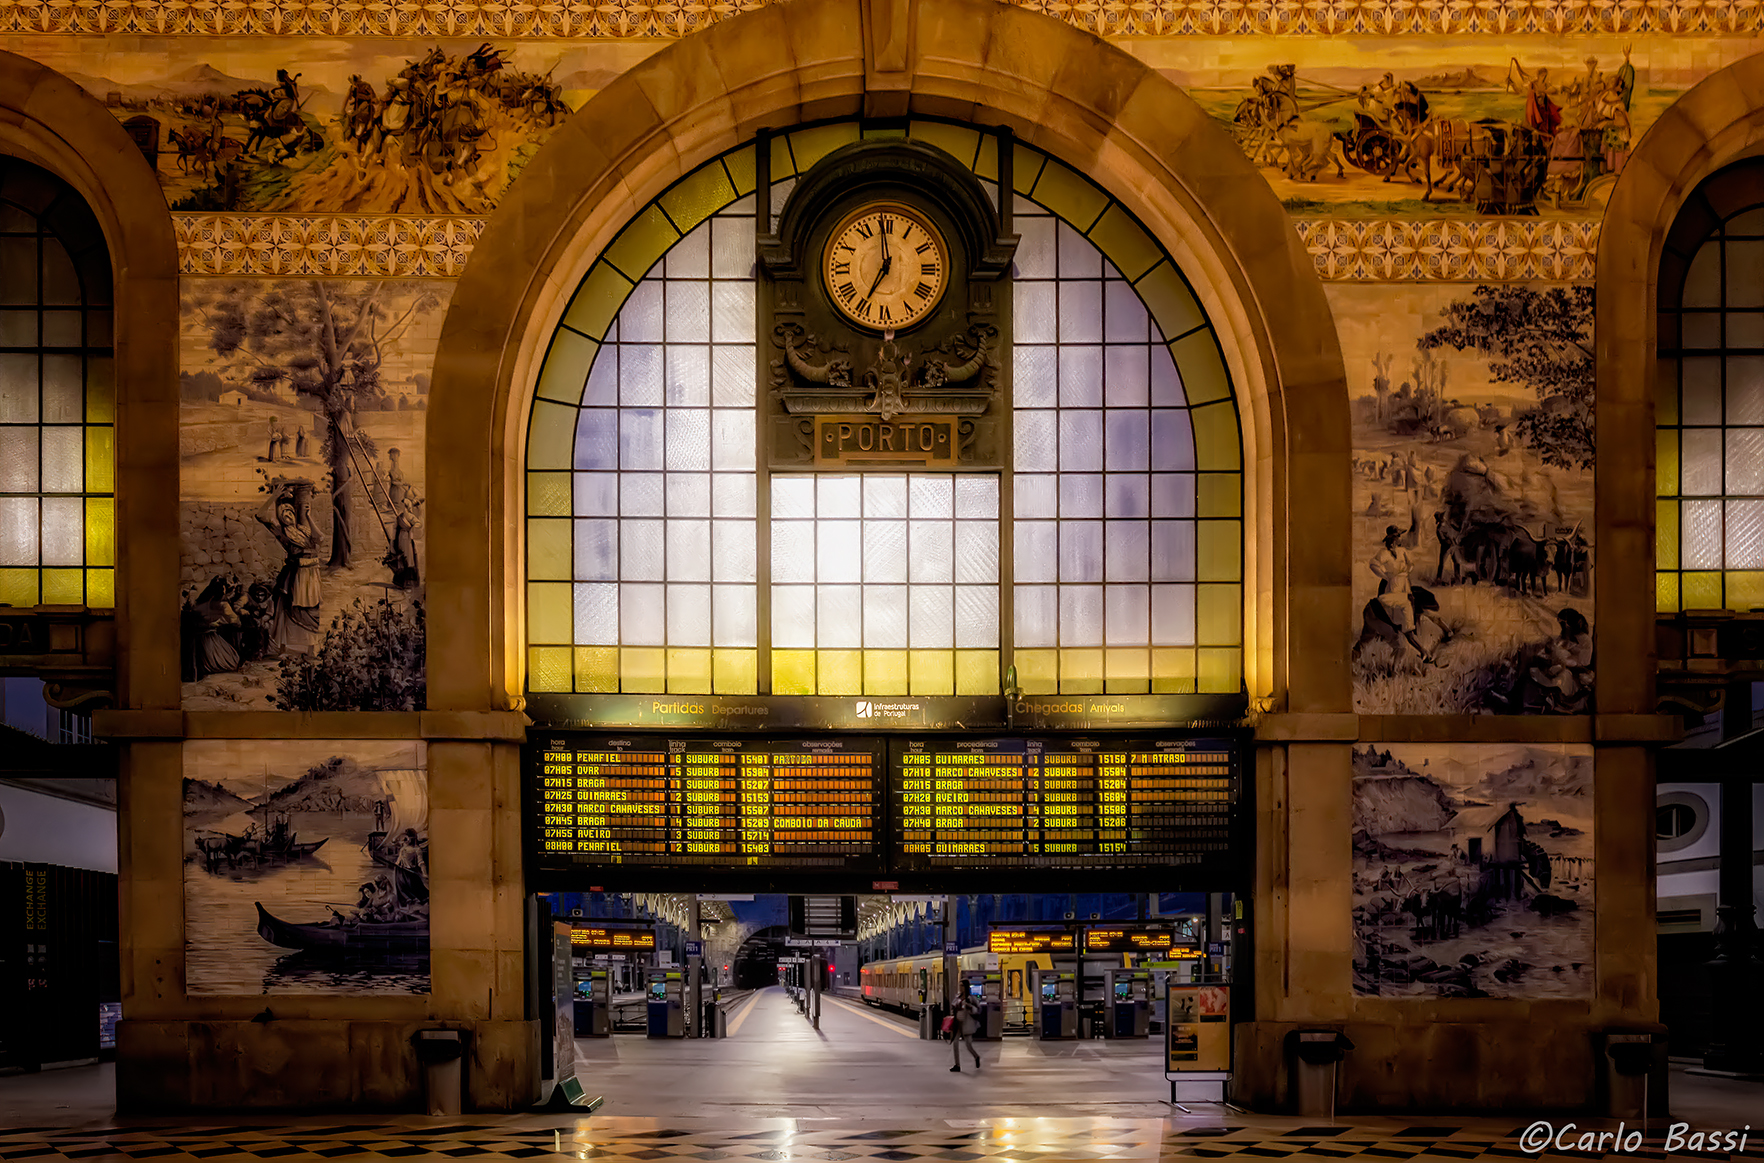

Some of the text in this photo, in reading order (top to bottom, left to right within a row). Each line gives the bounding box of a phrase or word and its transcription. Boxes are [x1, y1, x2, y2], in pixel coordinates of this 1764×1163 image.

[838, 424, 934, 451] PORTO
[652, 701, 769, 716] Partidas Departures
[874, 702, 920, 710] Infraestruturas
[1015, 701, 1125, 716] Chegadas Arrivals
[883, 710, 906, 719] Portugal
[544, 753, 572, 761] 07H00
[577, 754, 620, 762] PENAFIEL
[676, 755, 681, 763] 6
[687, 755, 719, 764] SUBURB
[741, 755, 769, 764] 15401
[903, 754, 1185, 764] 07H05 GUIMARAES 1 SUBURB 15150 7 M ATRASO
[544, 766, 769, 776] 07H05 OVAR 5 SUBURB 15904
[903, 767, 1126, 776] 07H10 MARCO CANAVESES 2 SUBURB 15504
[545, 779, 769, 789] 07H15 BRAGA 1 SUBURB 15207
[903, 780, 1126, 789] 07H15 BRAGA 3 SUBURB 15204
[545, 792, 769, 802] 07H25 GUIMARAES 2 SUBURB 15153
[903, 793, 1126, 802] 07H20 AVEIRO 1 SUBURB 15604
[545, 804, 769, 815] 07H30 MARCO CANAVESES 1 SUBURB 15507
[903, 805, 1126, 815] 07H30 MARCO CANAVESES 4 SUBURB 15506
[545, 817, 861, 828] 07H45 BRAGA 4 SUBURB 15209 COMBOIO DA CAUDA
[903, 818, 1126, 827] 07H40 BRAGA 2 SUBURB 15206
[545, 829, 769, 840] 07H55 AVEIRO 3 SUBURB 15714
[545, 842, 769, 853] 08H00 PENAFIEL 2 SUBURB 15403
[903, 844, 1126, 852] 08H05 GUIMARAES 5 SUBURB 15154
[26, 870, 34, 930] EXCHANGE
[37, 870, 46, 930] EXCHANGE
